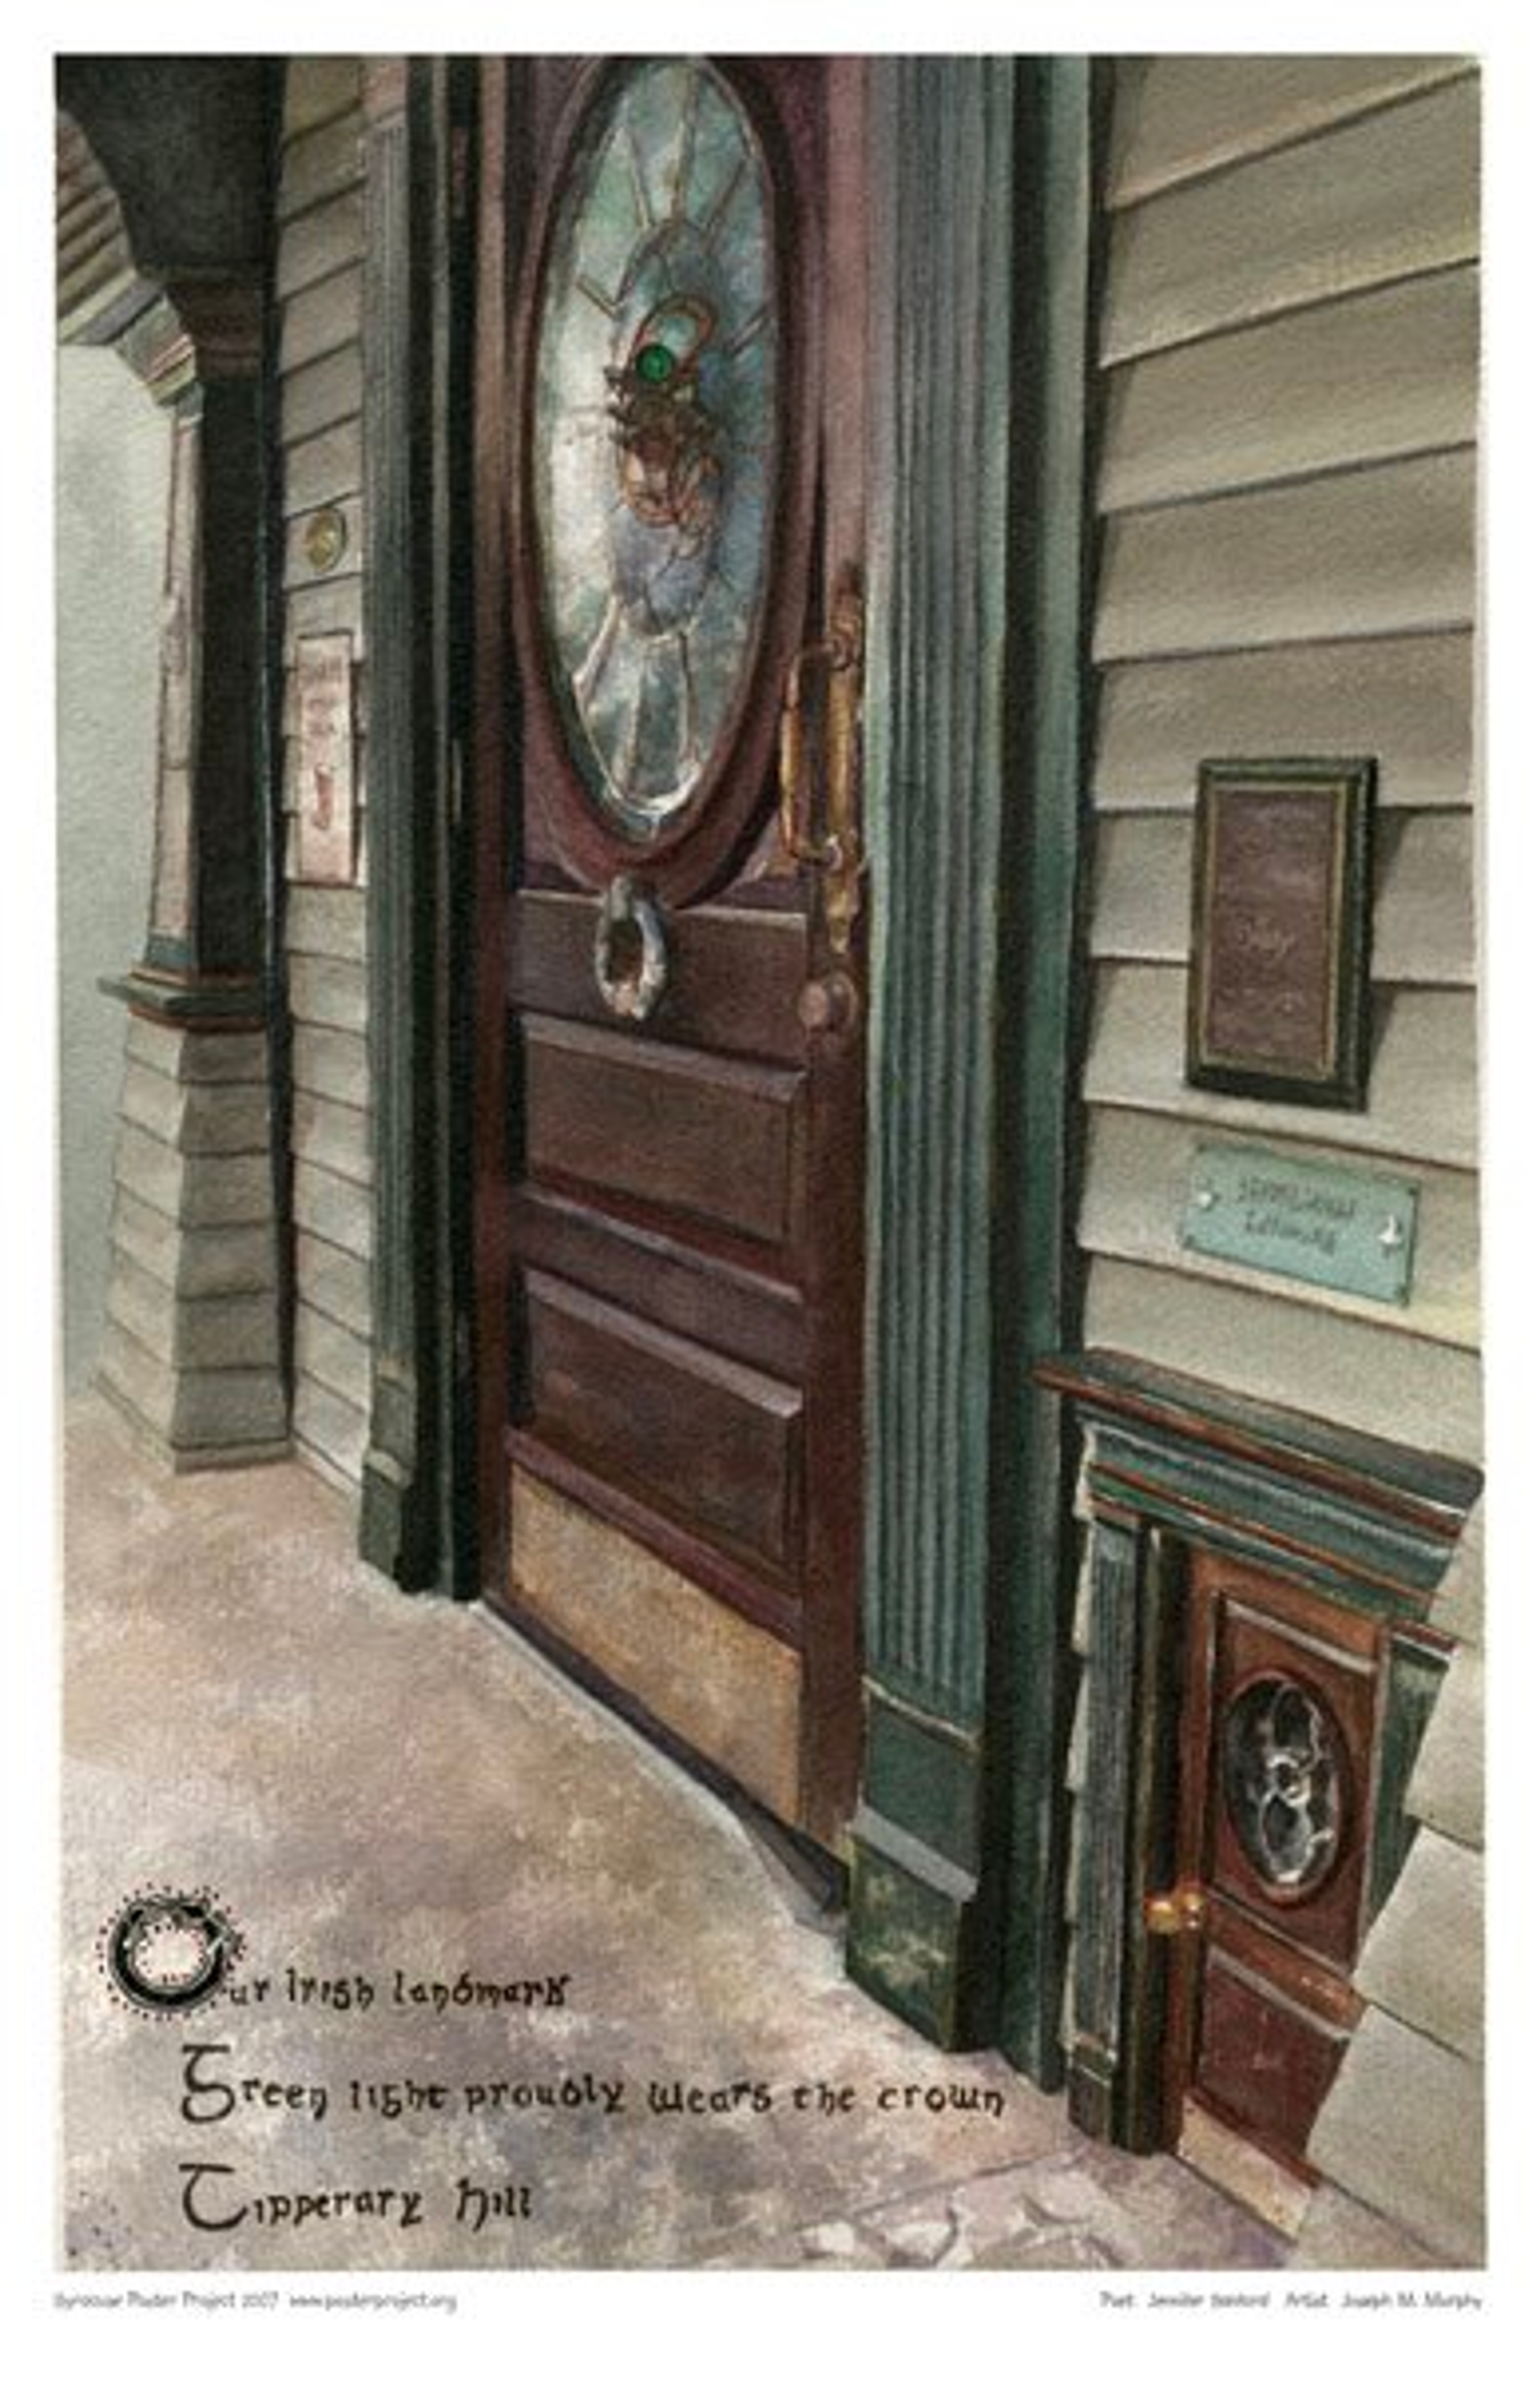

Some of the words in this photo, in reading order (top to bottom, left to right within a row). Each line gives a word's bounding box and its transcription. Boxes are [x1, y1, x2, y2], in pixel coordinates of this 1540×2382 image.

[107, 1892, 270, 2014] Our
[286, 1967, 375, 2011] Irish
[394, 1969, 571, 2014] landmark
[180, 2043, 327, 2123] Green
[350, 2078, 449, 2119] light
[463, 2072, 626, 2115] proudly
[645, 2080, 772, 2116] wears
[792, 2083, 856, 2117] the
[876, 2086, 1006, 2118] crown
[178, 2163, 423, 2229] Tipperary
[456, 2177, 532, 2231] Hill
[182, 2290, 237, 2311] Project
